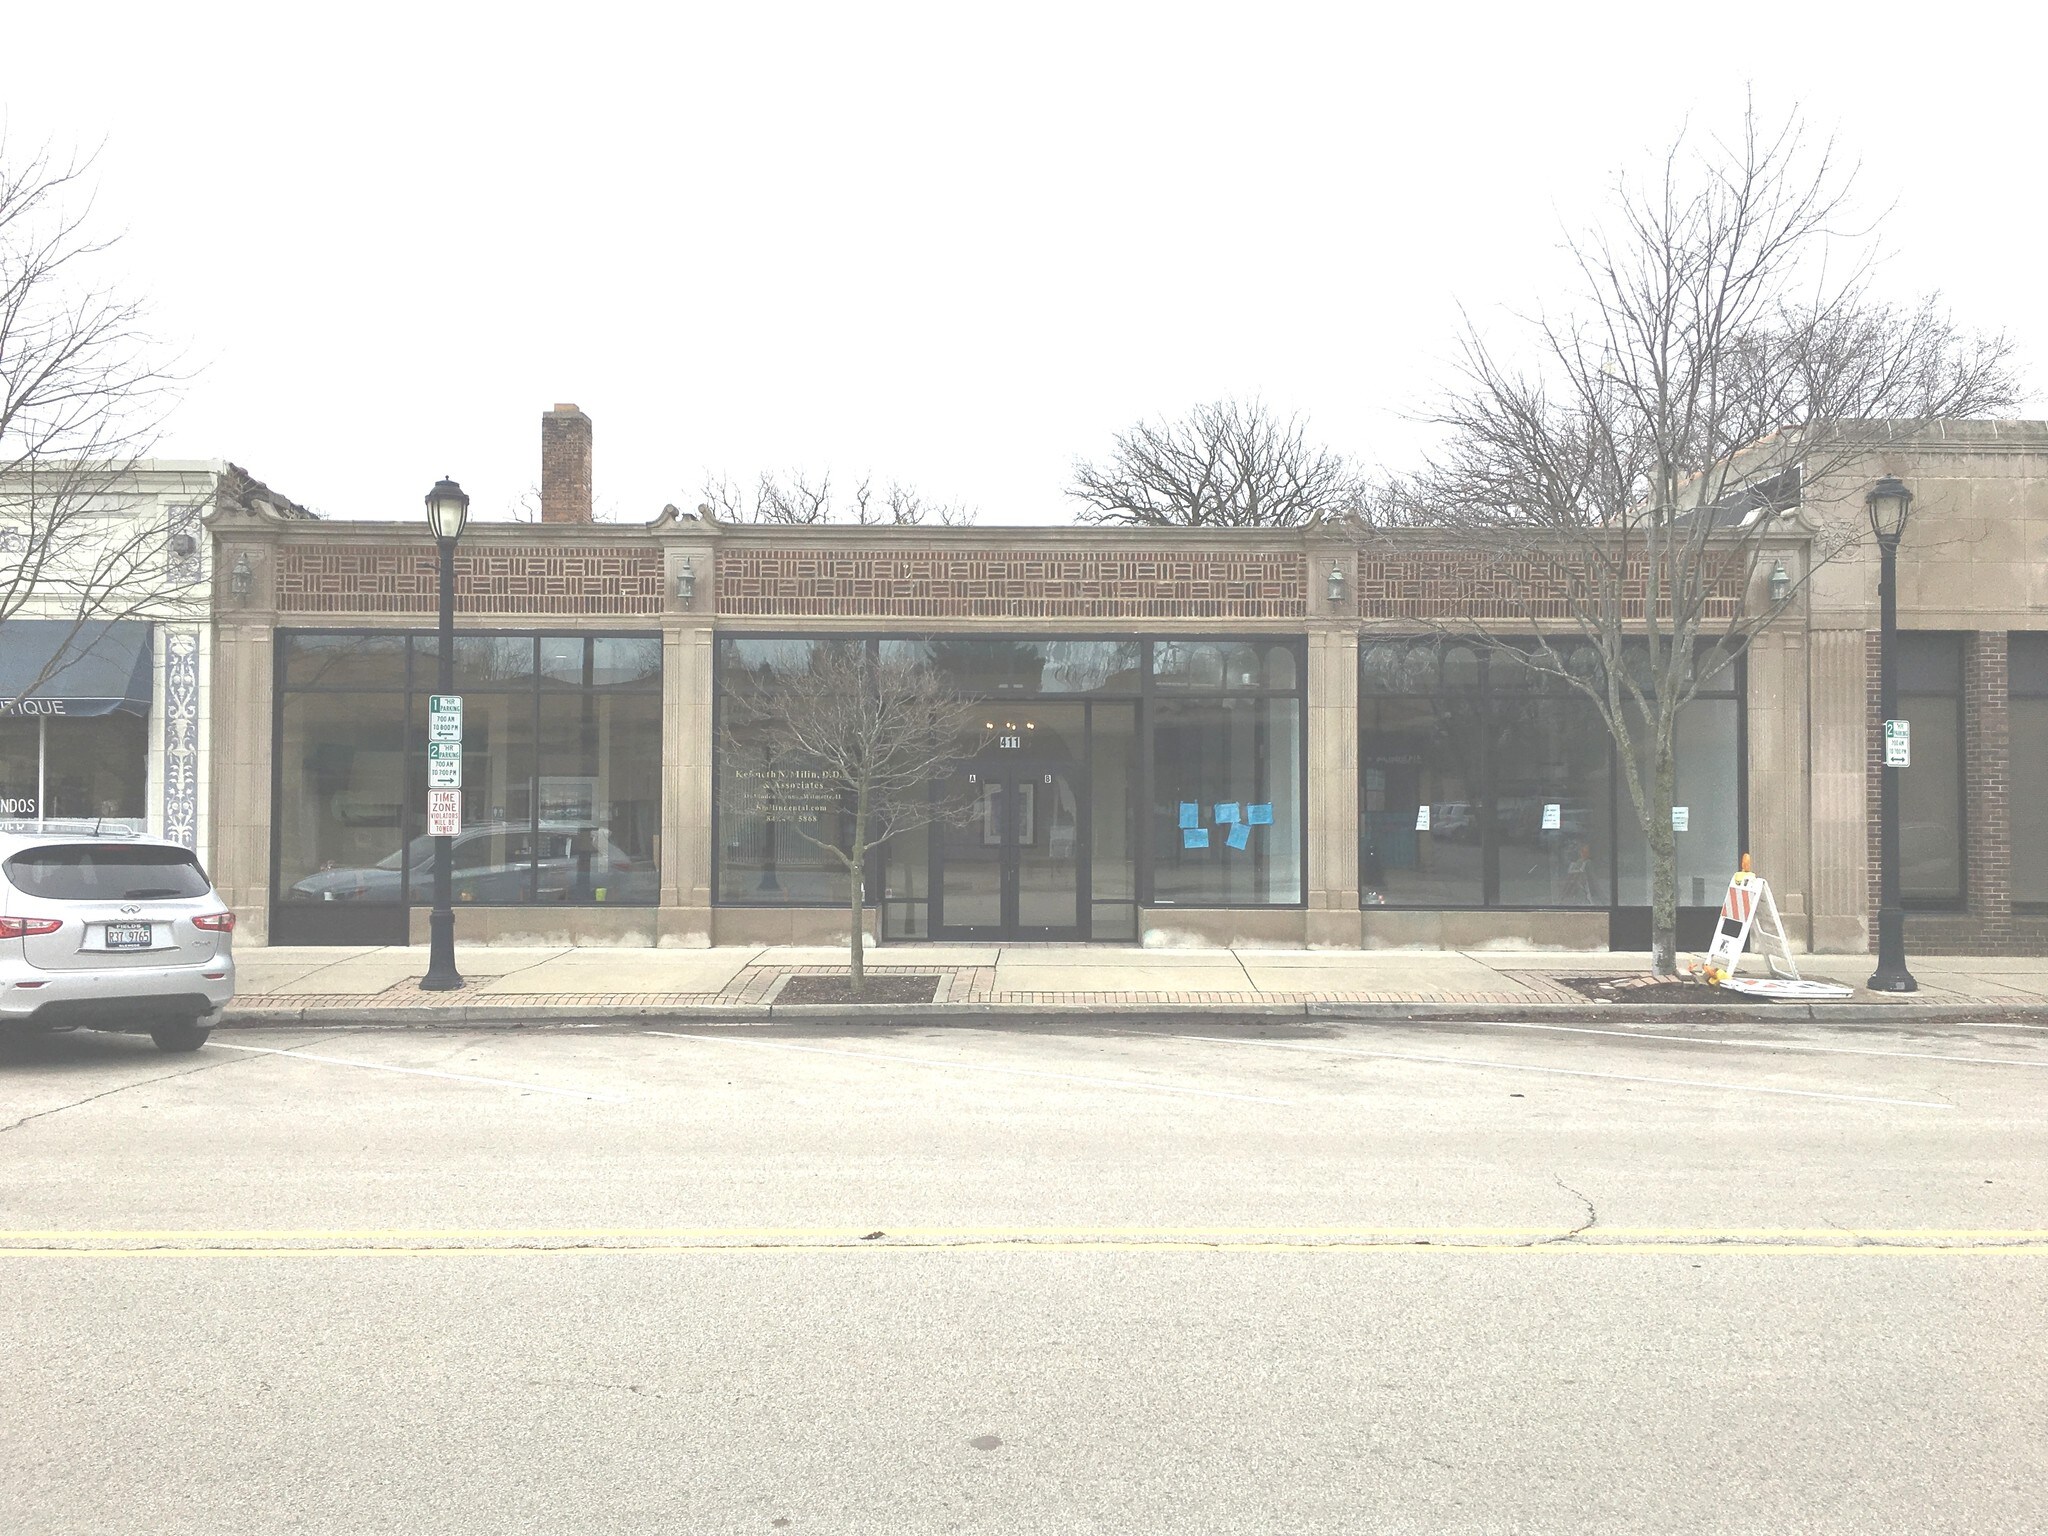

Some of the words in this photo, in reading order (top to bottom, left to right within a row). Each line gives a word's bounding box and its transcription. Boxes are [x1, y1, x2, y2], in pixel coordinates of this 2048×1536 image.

[433, 699, 437, 711] 1
[1887, 723, 1893, 735] 2
[1000, 737, 1020, 748] 411
[430, 745, 438, 758] 2
[434, 793, 455, 802] TIME
[432, 803, 457, 812] ZONE
[109, 931, 124, 943] R37
[128, 931, 149, 943] 9765
